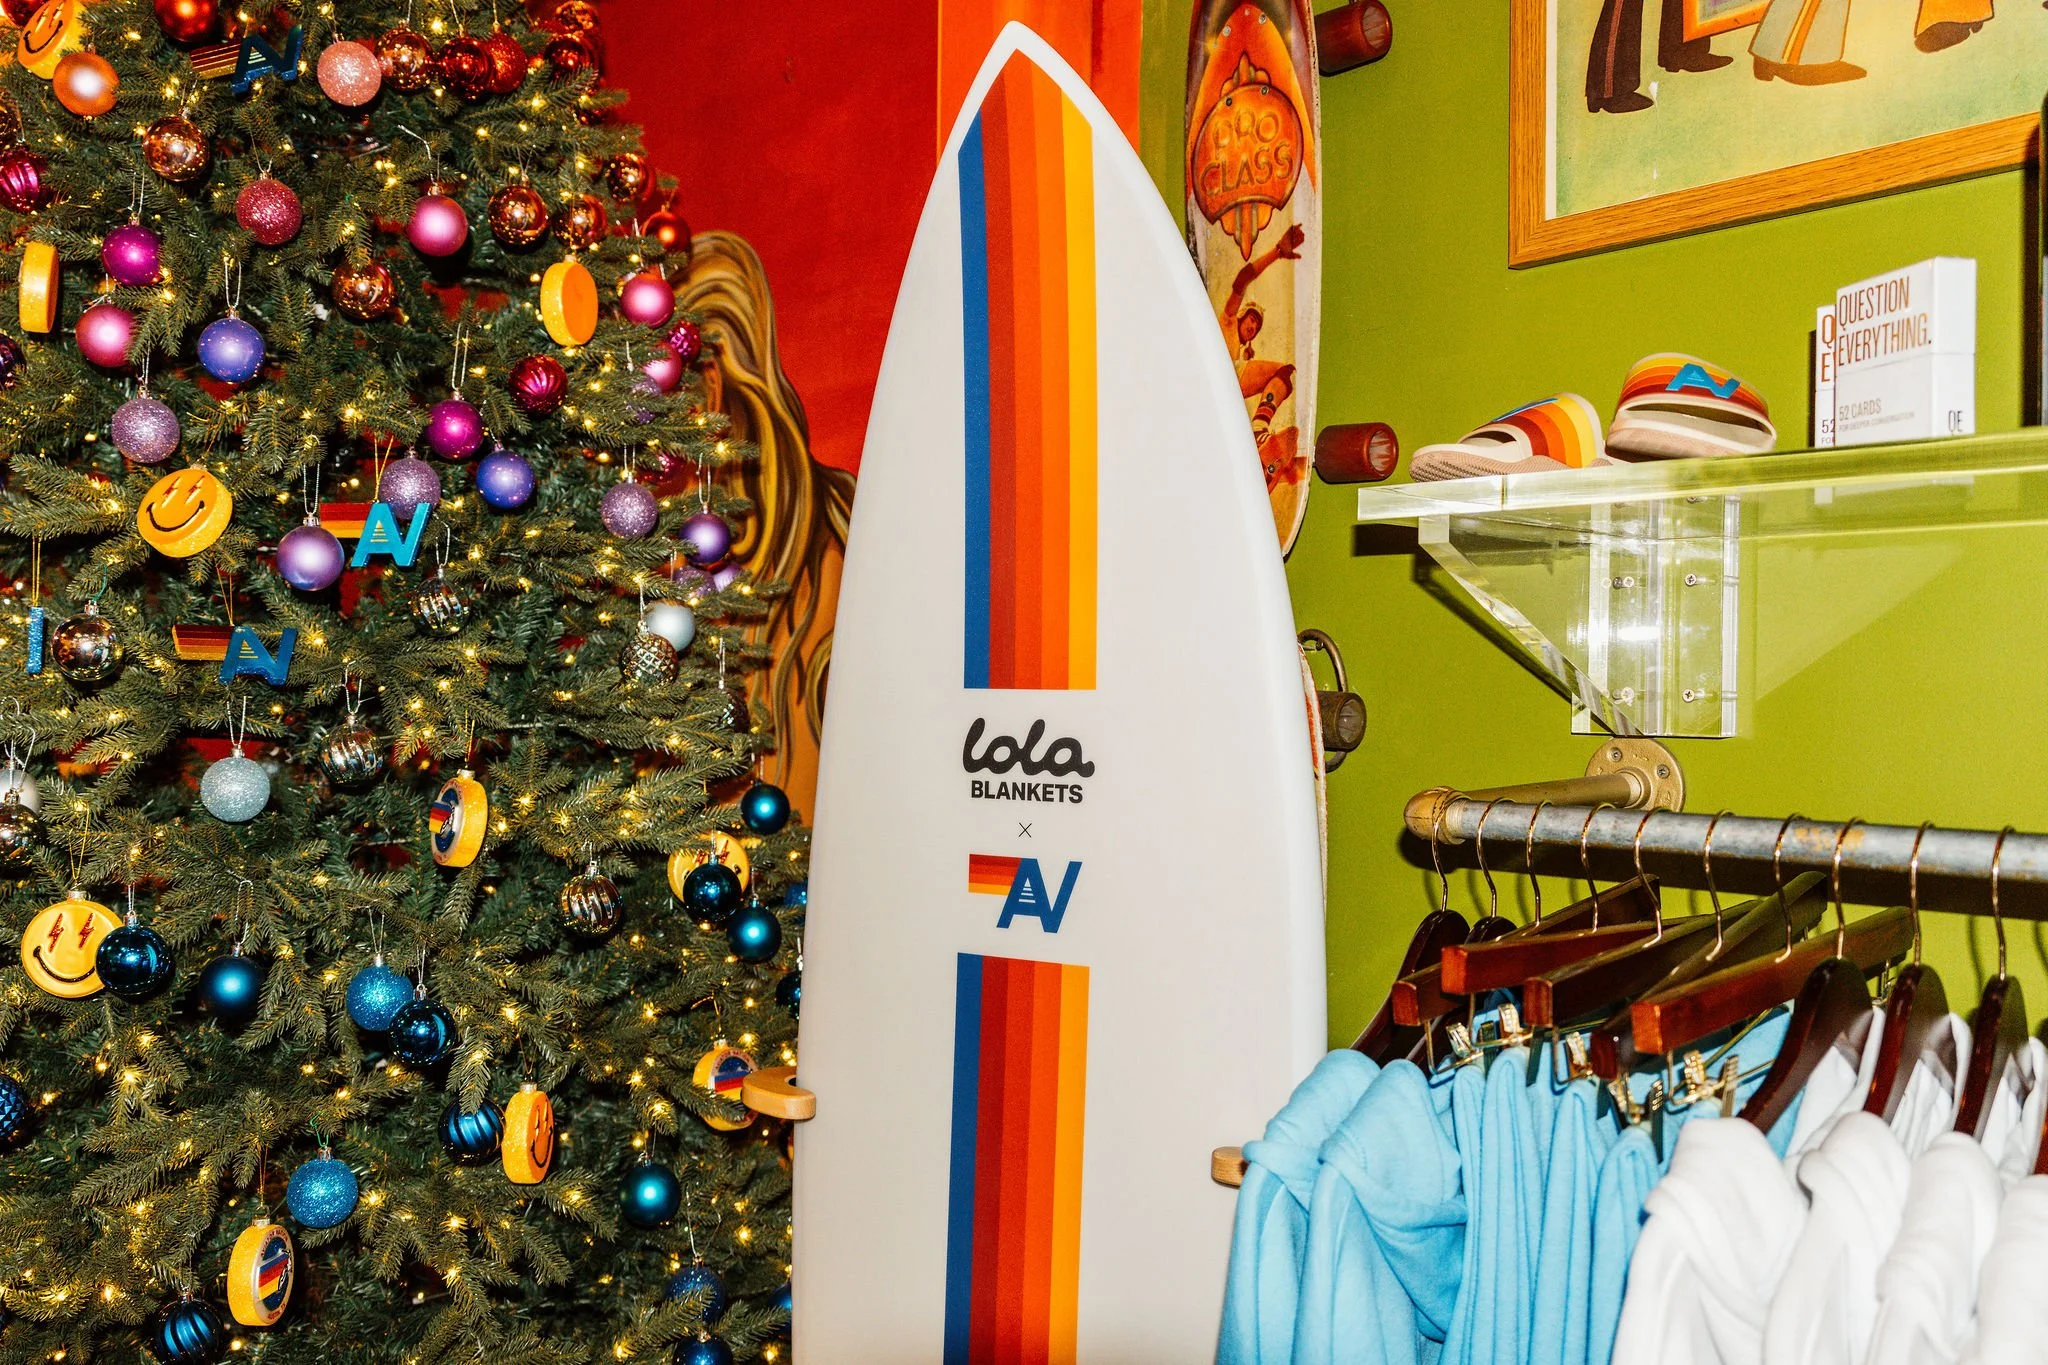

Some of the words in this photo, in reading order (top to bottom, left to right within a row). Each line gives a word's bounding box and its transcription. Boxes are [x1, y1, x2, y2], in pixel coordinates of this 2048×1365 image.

[1213, 108, 1280, 161] PRO
[1200, 140, 1294, 197] CLASS
[1838, 276, 1911, 331] QUESTION
[1837, 313, 1932, 367] EVERYTHING.
[1839, 405, 1849, 421] 52
[1851, 398, 1882, 418] CARDS
[1948, 410, 1963, 436] QE
[962, 717, 1095, 778] lola
[971, 780, 1083, 804] BLANKETS
